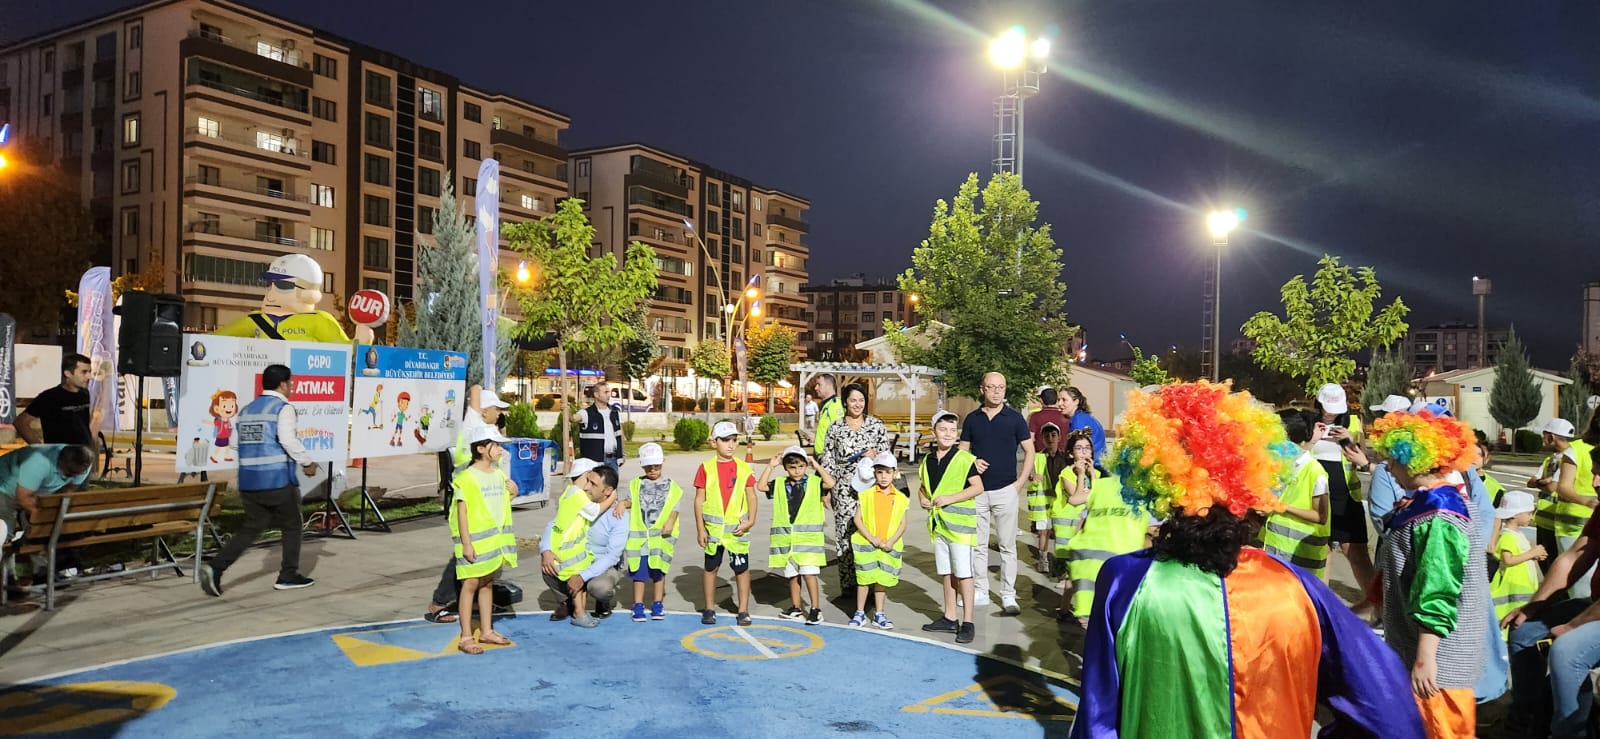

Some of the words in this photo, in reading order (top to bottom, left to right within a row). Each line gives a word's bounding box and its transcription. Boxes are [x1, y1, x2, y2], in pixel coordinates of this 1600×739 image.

[351, 294, 383, 317] DUR
[404, 360, 440, 370] DİYARBAKIR
[385, 369, 423, 379] BÜYÜKŞEHİR
[424, 371, 455, 379] BELEDİYESİ
[296, 380, 335, 395] ATMAK
[302, 436, 334, 450] arkı
